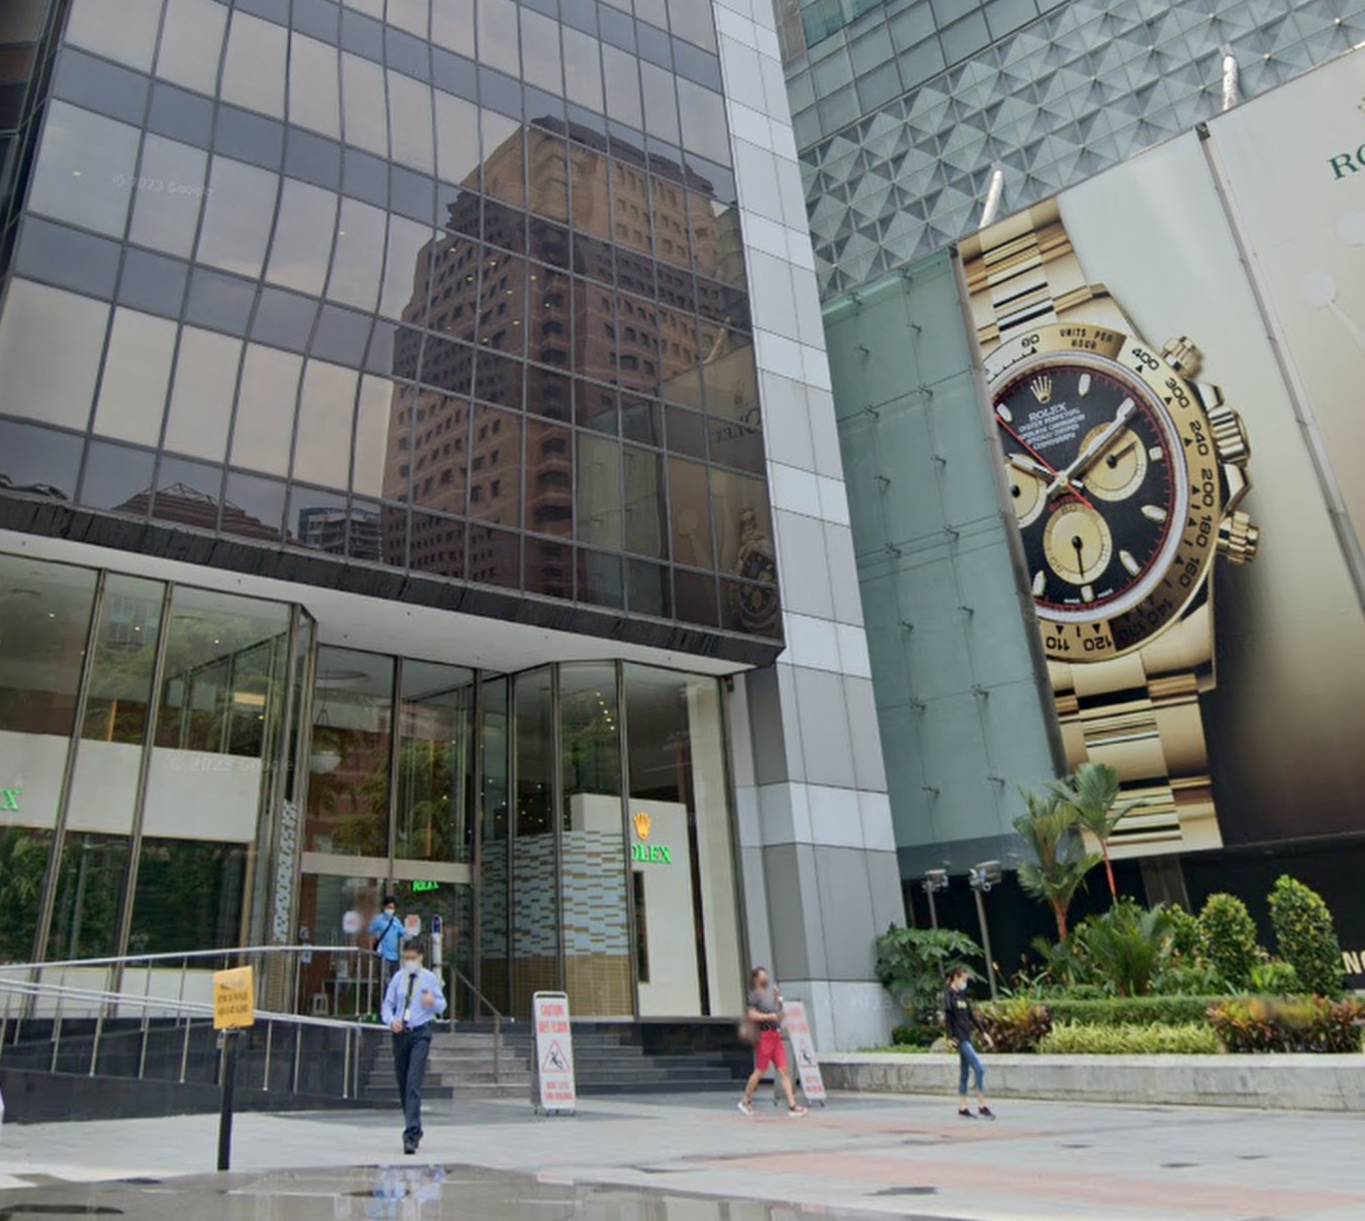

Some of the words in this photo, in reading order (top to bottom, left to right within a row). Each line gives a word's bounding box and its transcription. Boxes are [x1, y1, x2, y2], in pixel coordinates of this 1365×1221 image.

[1132, 347, 1160, 371] 400
[1164, 377, 1190, 409] 300
[1028, 401, 1067, 422] ROLEX
[1189, 420, 1209, 456] 240
[1199, 467, 1215, 507] 200
[1196, 514, 1212, 548] 180
[1179, 556, 1200, 587] 160
[1046, 636, 1070, 651] 110
[1084, 635, 1112, 652] 120
[631, 843, 672, 864] OLEX
